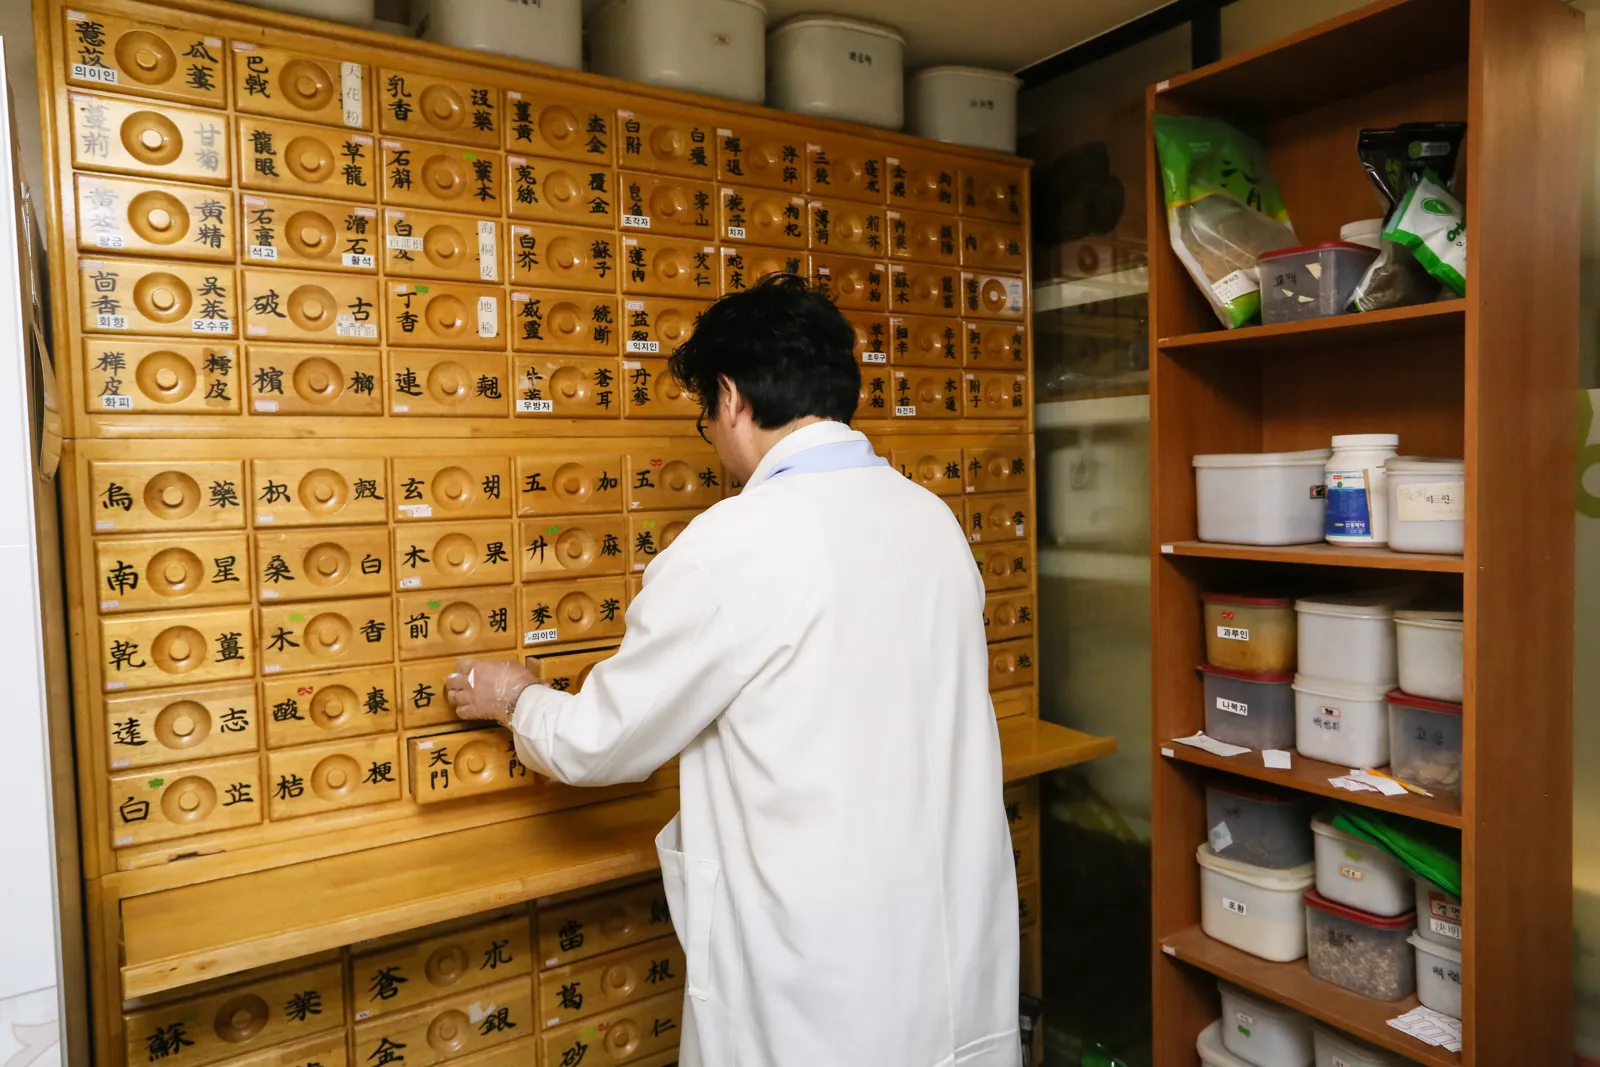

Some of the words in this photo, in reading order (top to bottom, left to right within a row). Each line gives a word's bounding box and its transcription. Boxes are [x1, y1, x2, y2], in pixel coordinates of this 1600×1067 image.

[74, 66, 116, 82] 의이인
[244, 56, 270, 98] 巴戟
[346, 65, 360, 125] 天花粉
[386, 75, 413, 121] 乳香
[194, 124, 221, 172] 甘菊
[250, 131, 279, 177] 龍眼
[341, 142, 367, 187] 草龍
[250, 208, 275, 246] 石膏
[344, 214, 370, 255] 滑石
[624, 217, 648, 226] 조각자
[730, 229, 744, 237] 치자
[251, 246, 275, 258] 석고
[351, 256, 372, 266] 활석
[481, 222, 494, 277] 海桐皮
[516, 234, 539, 272] 白芥
[89, 271, 122, 316] 茴香
[247, 289, 286, 319] 破
[347, 297, 374, 322] 古
[99, 316, 125, 328] 회향
[193, 320, 230, 332] 오수유
[396, 292, 419, 333] 丁香
[633, 342, 657, 352] 익지인
[252, 367, 286, 395] 檳
[395, 368, 423, 396] 連
[593, 368, 613, 410] 蒼耳
[104, 397, 130, 408] 화피
[523, 402, 550, 411] 우방자
[897, 408, 914, 416] 차전자
[633, 470, 655, 488] 五
[698, 467, 719, 488] 味
[968, 457, 982, 477] 牛
[99, 482, 133, 511] 烏
[208, 480, 240, 508] 藥
[401, 478, 425, 500] 玄
[481, 474, 500, 499] 胡
[522, 473, 547, 493] 五
[596, 471, 618, 492] 加
[973, 513, 983, 530] 貝
[401, 545, 430, 568] 木
[482, 541, 509, 564] 果
[526, 535, 548, 564] 升
[600, 534, 622, 556] 麻
[106, 560, 139, 596] 南
[211, 556, 240, 584] 星
[264, 554, 295, 584] 桑
[361, 554, 383, 576] 白
[267, 627, 300, 651] 木
[359, 619, 386, 643] 香
[404, 612, 431, 639] 前
[488, 607, 508, 633] 胡
[531, 630, 557, 640] 의이인
[1223, 629, 1248, 640] 과루인
[109, 640, 146, 671] 乾
[411, 683, 436, 709] 杏
[1222, 700, 1247, 715] 나복자
[219, 708, 249, 733] 志
[272, 699, 305, 722] 酸
[272, 774, 303, 799] 桔
[362, 761, 396, 784] 梗
[428, 747, 452, 790] 天門
[119, 796, 150, 823] 白
[1228, 901, 1245, 914] 포황
[1435, 921, 1460, 938] 決明
[369, 967, 408, 1002] 蒼
[556, 983, 583, 1010] 葛
[645, 959, 675, 984] 根
[367, 1038, 407, 1067] 金
[480, 1007, 516, 1035] 銀
[653, 1019, 676, 1037] 仁
